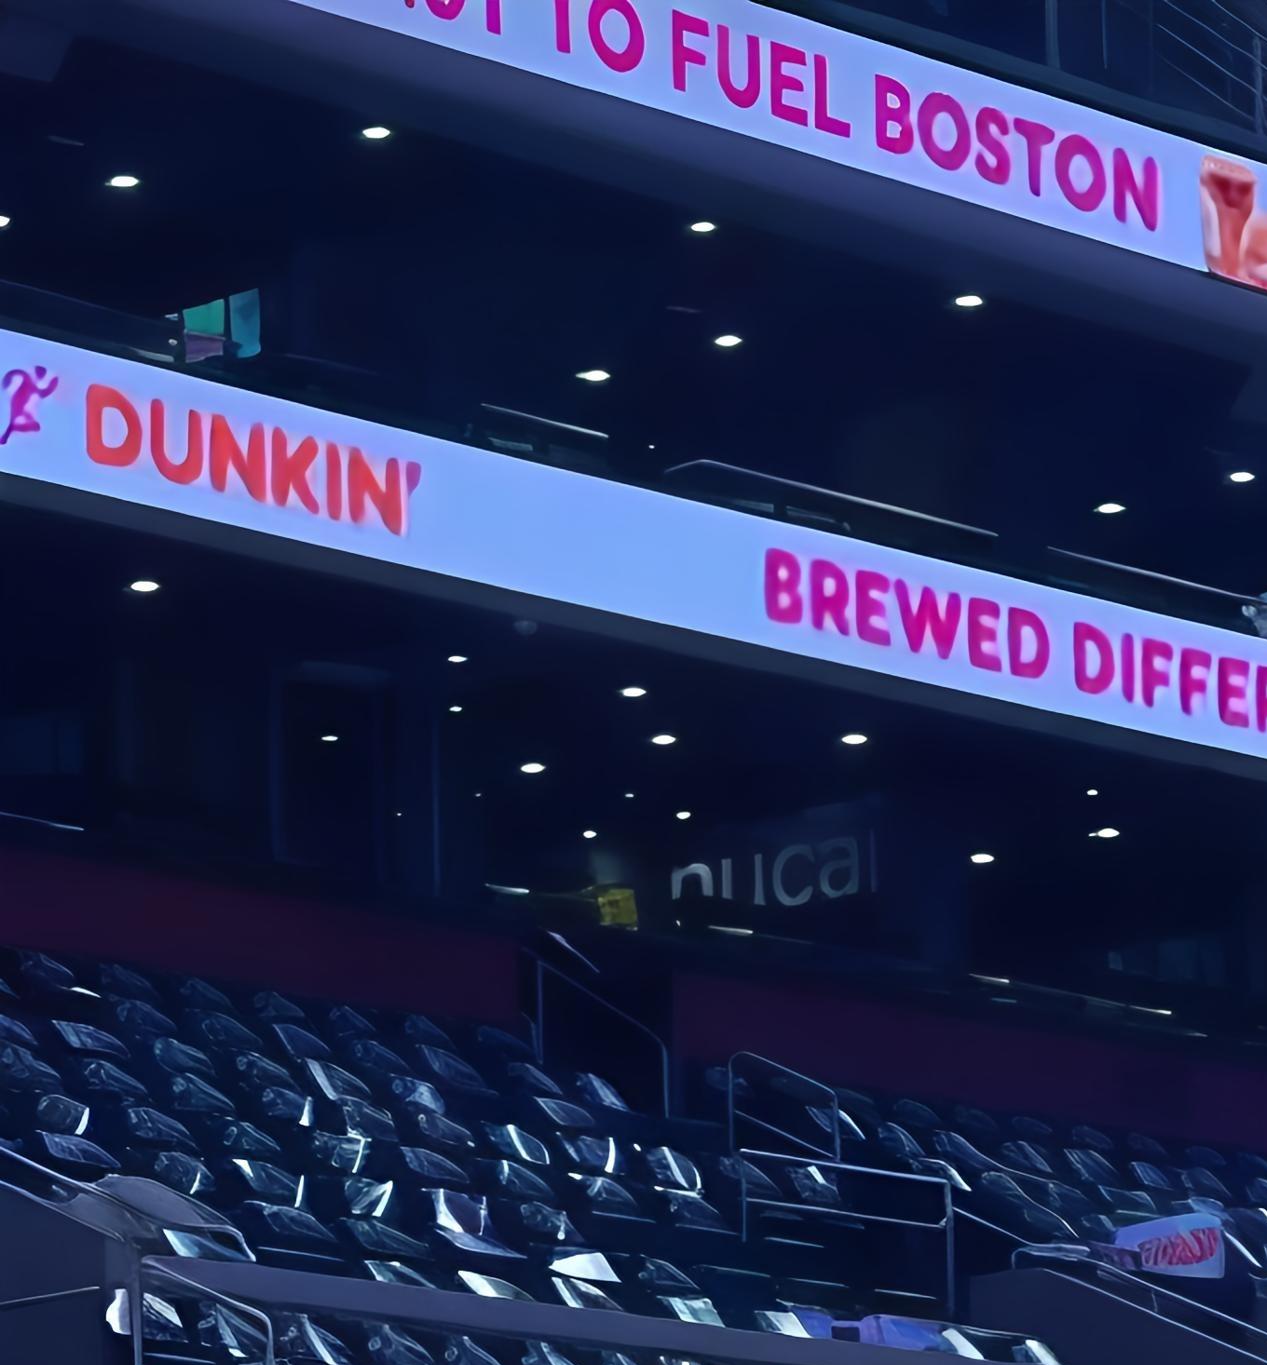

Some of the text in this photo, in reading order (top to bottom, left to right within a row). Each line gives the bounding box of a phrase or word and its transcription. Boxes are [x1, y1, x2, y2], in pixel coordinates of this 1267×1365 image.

[671, 9, 853, 138] FUEL
[874, 74, 1162, 231] BOSTON
[764, 547, 1051, 679] BREWED
